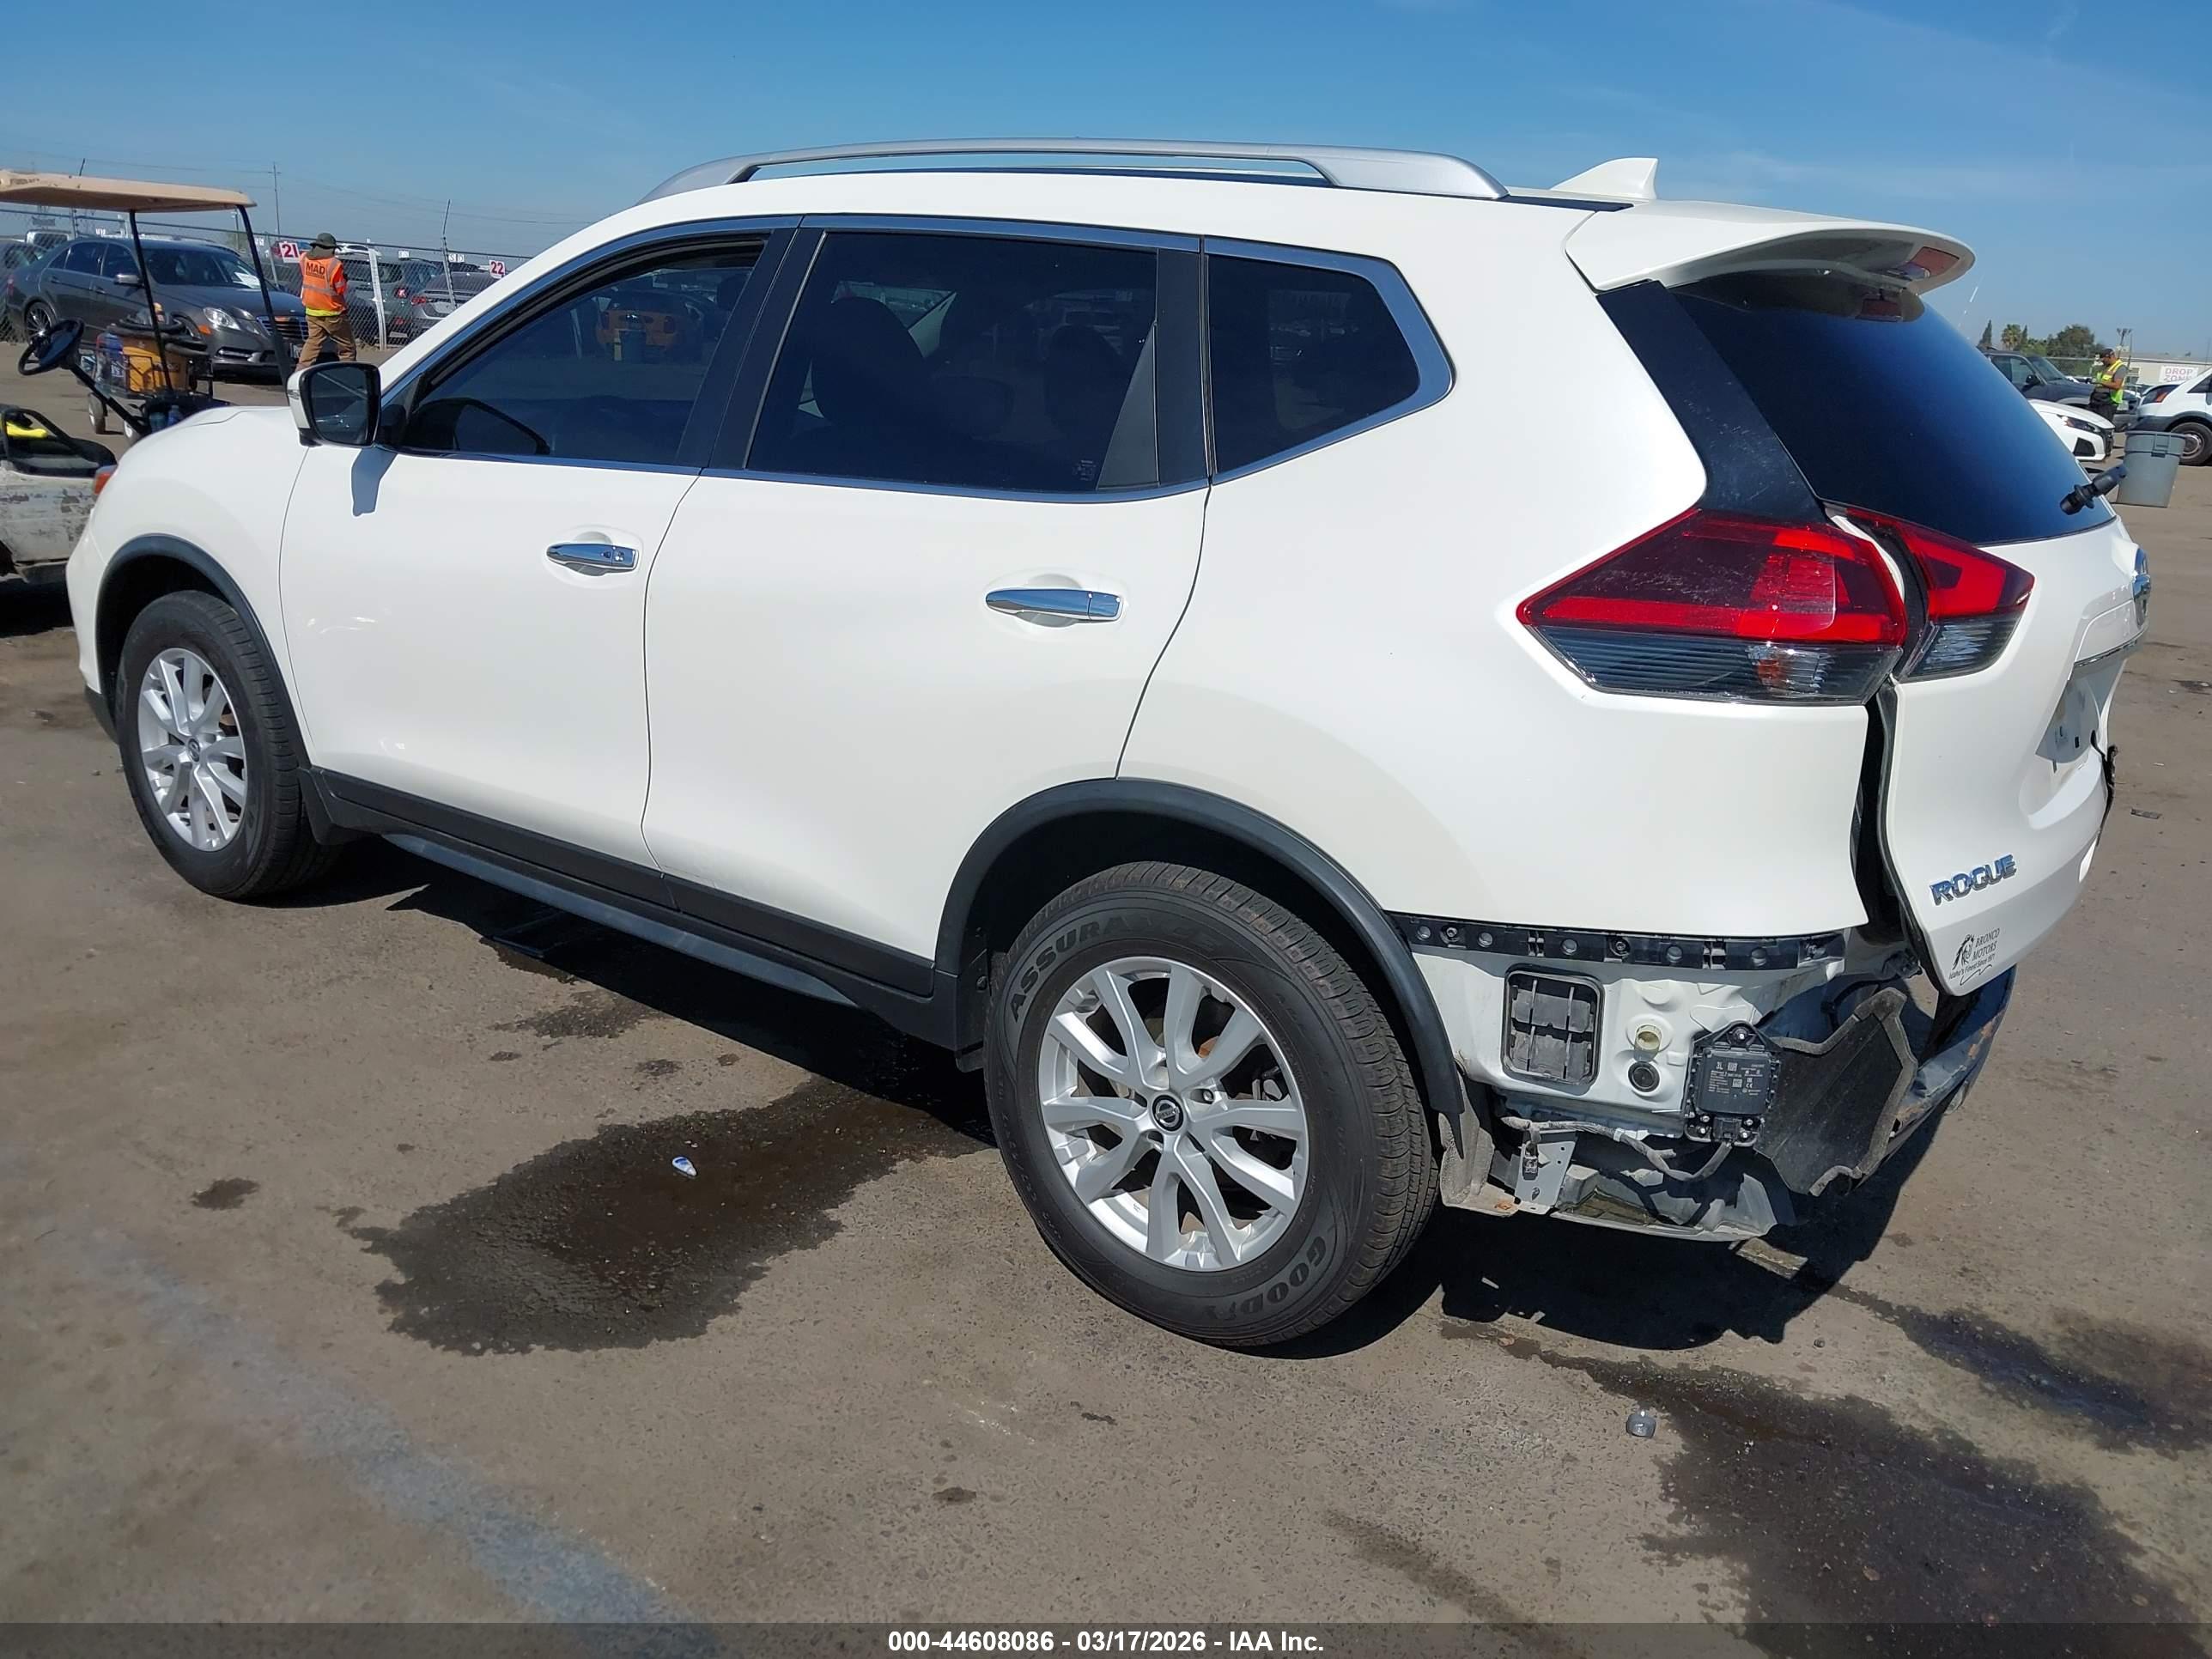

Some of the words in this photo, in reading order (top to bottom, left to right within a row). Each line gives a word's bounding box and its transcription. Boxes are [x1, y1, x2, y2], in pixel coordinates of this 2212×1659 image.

[281, 244, 299, 258] 21
[306, 262, 325, 275] MAD
[490, 261, 505, 275] 22
[1929, 854, 2017, 906] ROGUE
[1976, 928, 2000, 947] BRONCO
[1972, 940, 1997, 961] MOTORS
